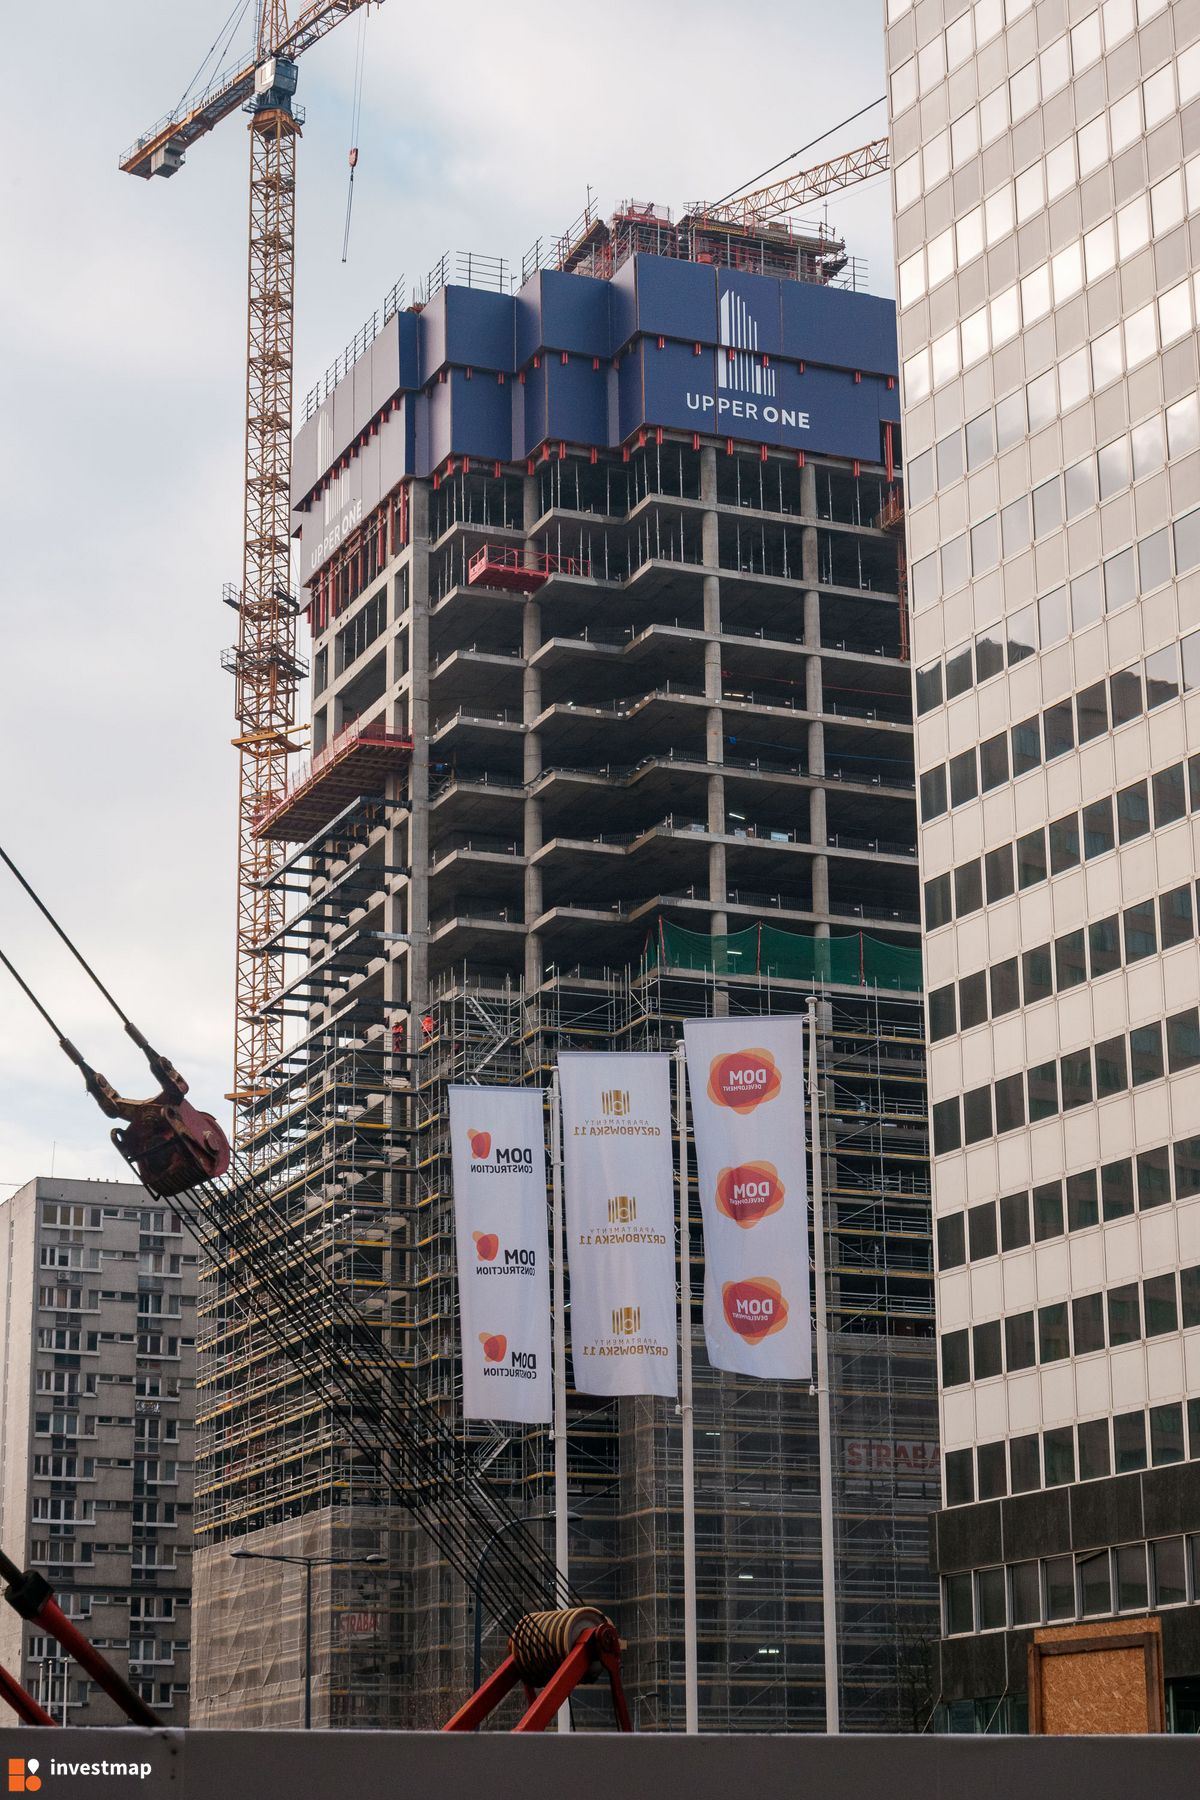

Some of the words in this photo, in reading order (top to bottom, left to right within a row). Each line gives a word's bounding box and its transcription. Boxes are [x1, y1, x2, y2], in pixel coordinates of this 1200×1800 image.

[686, 392, 758, 420] UPPER
[763, 406, 810, 429] ONE
[311, 525, 340, 569] UPPER
[342, 499, 362, 535] ONE
[341, 1614, 383, 1632] STRABA
